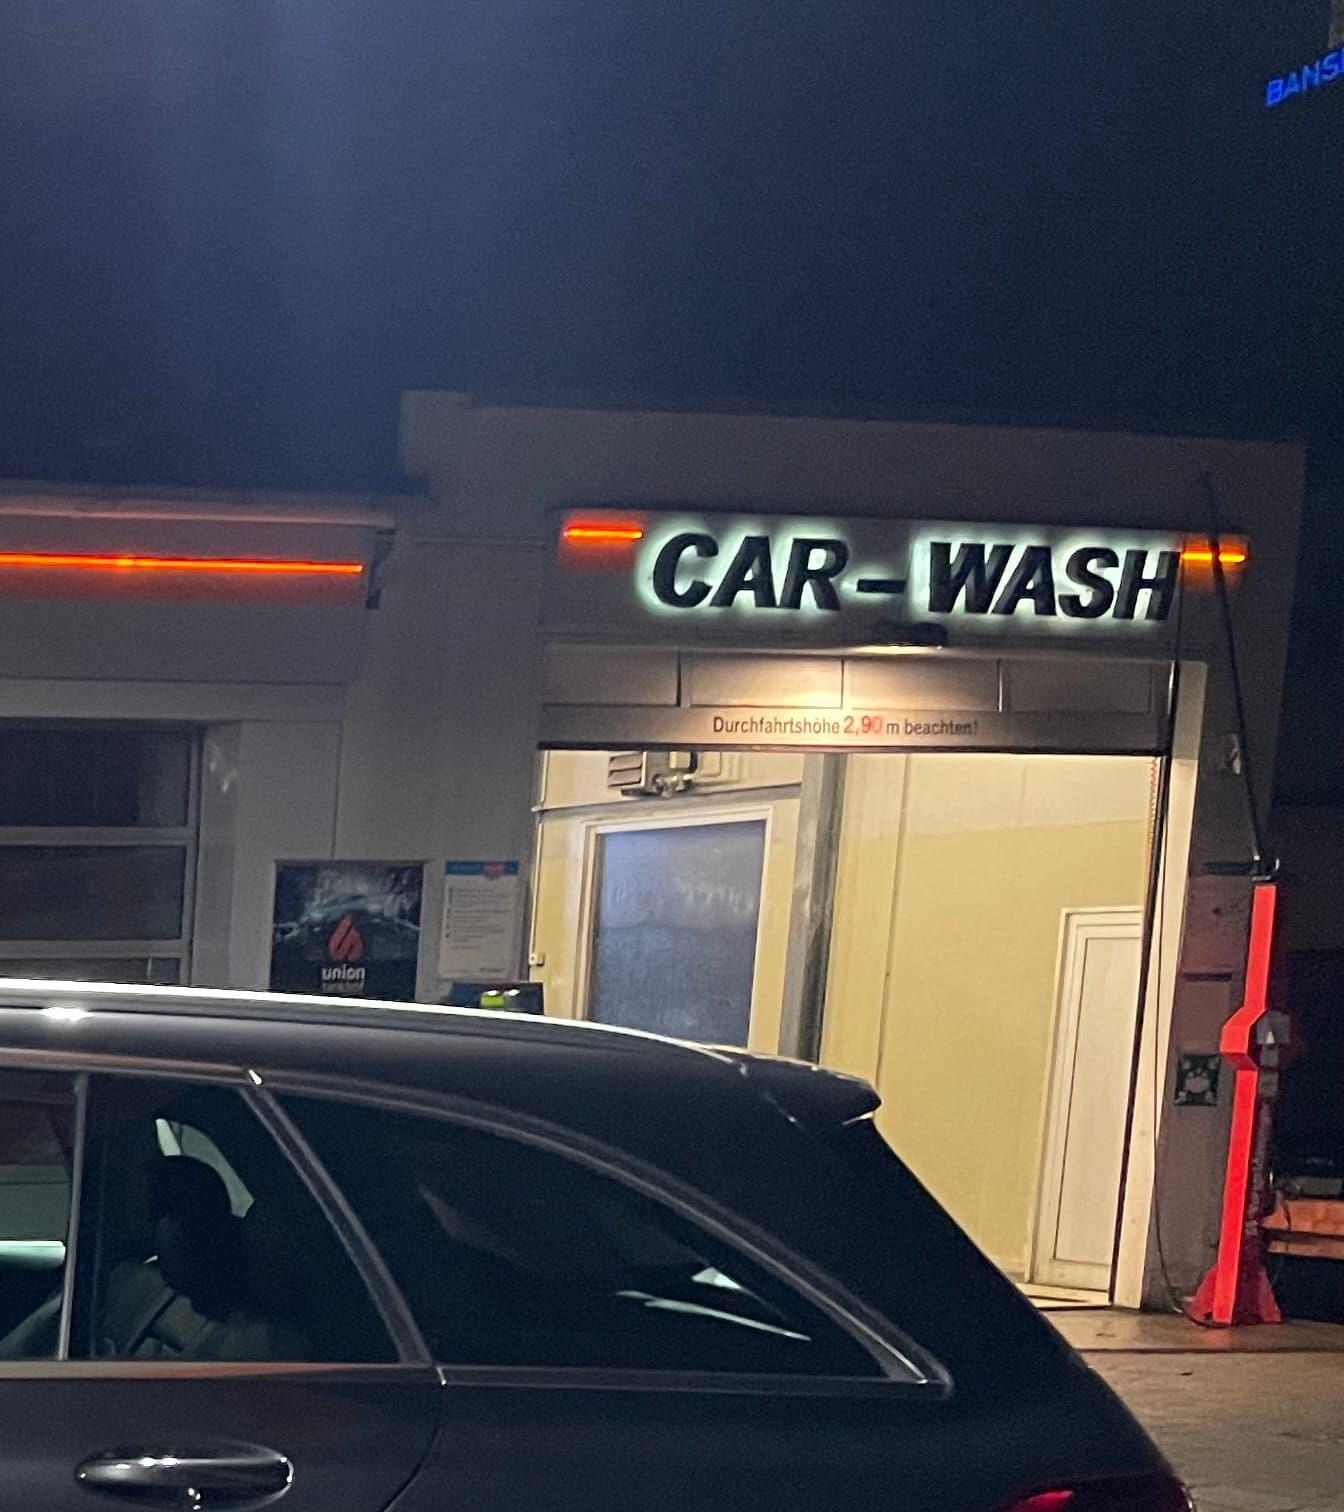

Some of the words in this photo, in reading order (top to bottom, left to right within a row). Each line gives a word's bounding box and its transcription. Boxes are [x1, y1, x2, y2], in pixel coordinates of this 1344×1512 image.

[1265, 45, 1344, 107] BANS
[712, 715, 841, 735] Durchfahrtshöhe
[843, 716, 883, 737] 2,90
[886, 719, 900, 735] m
[904, 717, 979, 736] beachten!
[321, 966, 366, 984] union
